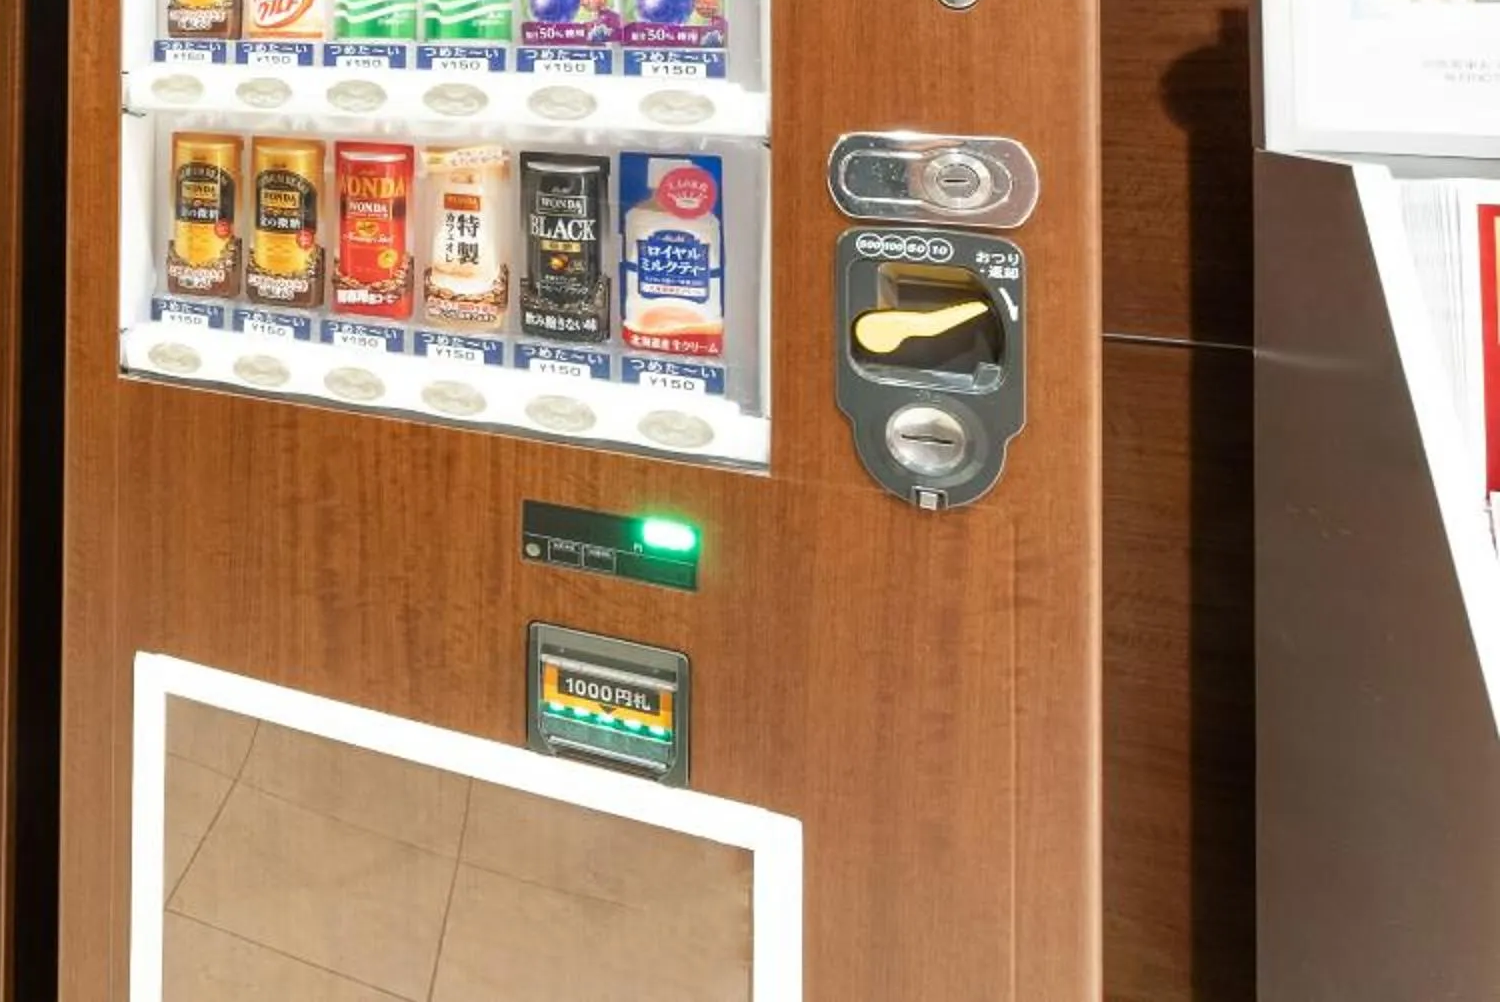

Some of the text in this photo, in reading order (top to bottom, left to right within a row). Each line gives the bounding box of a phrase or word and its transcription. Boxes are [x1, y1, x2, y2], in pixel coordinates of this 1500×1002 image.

[530, 214, 597, 242] BLACK
[457, 213, 480, 265] 特製
[648, 245, 701, 261] ロイヤル
[975, 251, 1019, 267] おつり
[640, 258, 707, 276] ミルクティー
[649, 375, 696, 392] ¥150
[565, 676, 652, 711] 1000円札
